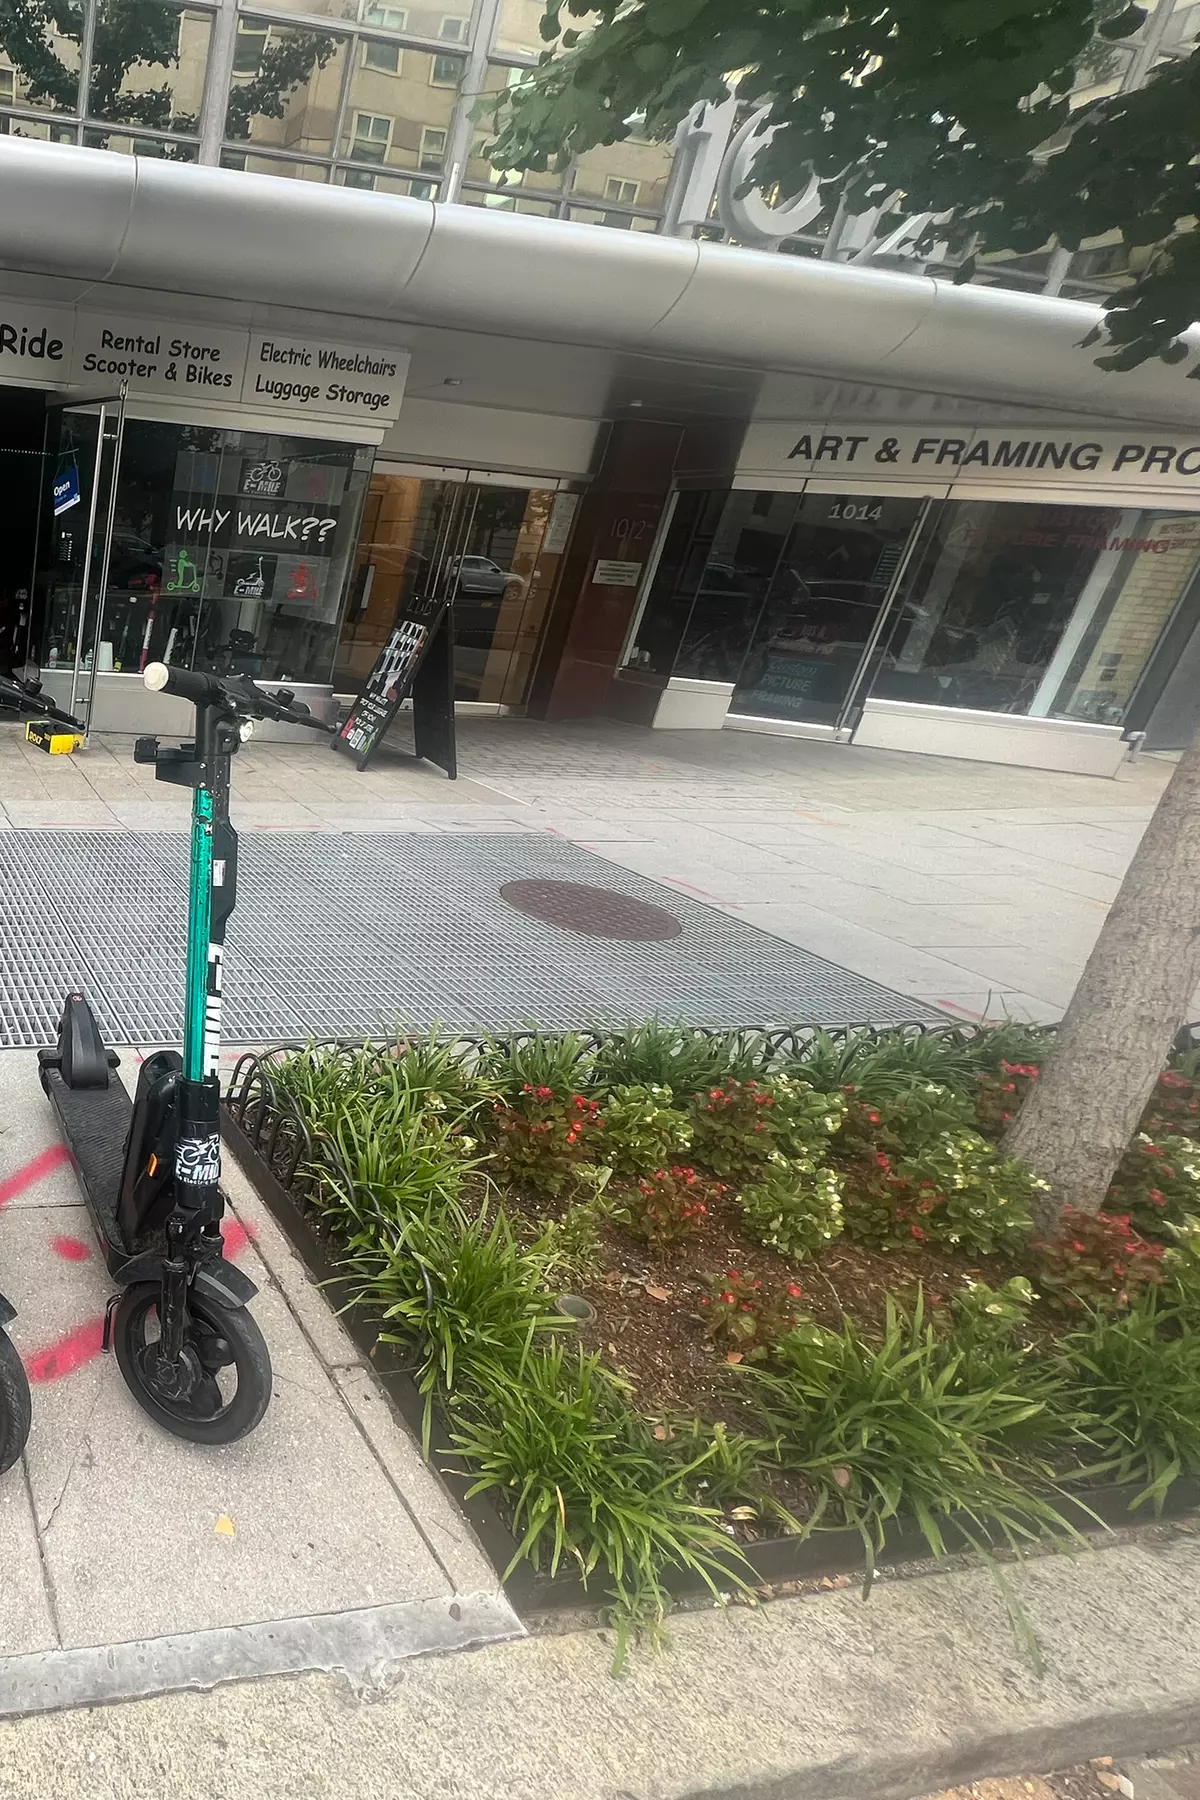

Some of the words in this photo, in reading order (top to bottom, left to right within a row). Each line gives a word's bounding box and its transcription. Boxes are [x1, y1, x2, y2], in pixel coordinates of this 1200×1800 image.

[100, 329, 161, 356] Rental
[168, 339, 221, 362] Store
[260, 342, 312, 367] Electric
[318, 353, 397, 378] Wheelchairs
[83, 353, 157, 379] Scooter
[164, 362, 178, 382] &
[186, 364, 233, 388] Bikes
[255, 373, 320, 403] Luggage
[325, 384, 391, 411] Storage
[787, 434, 869, 462] ART
[874, 436, 901, 463] &
[912, 437, 1104, 471] FRAMING
[53, 481, 71, 497] Open
[176, 505, 230, 533] WHY
[237, 510, 337, 542] WALK??
[827, 503, 883, 521] 1014
[760, 673, 812, 692] PICTURE
